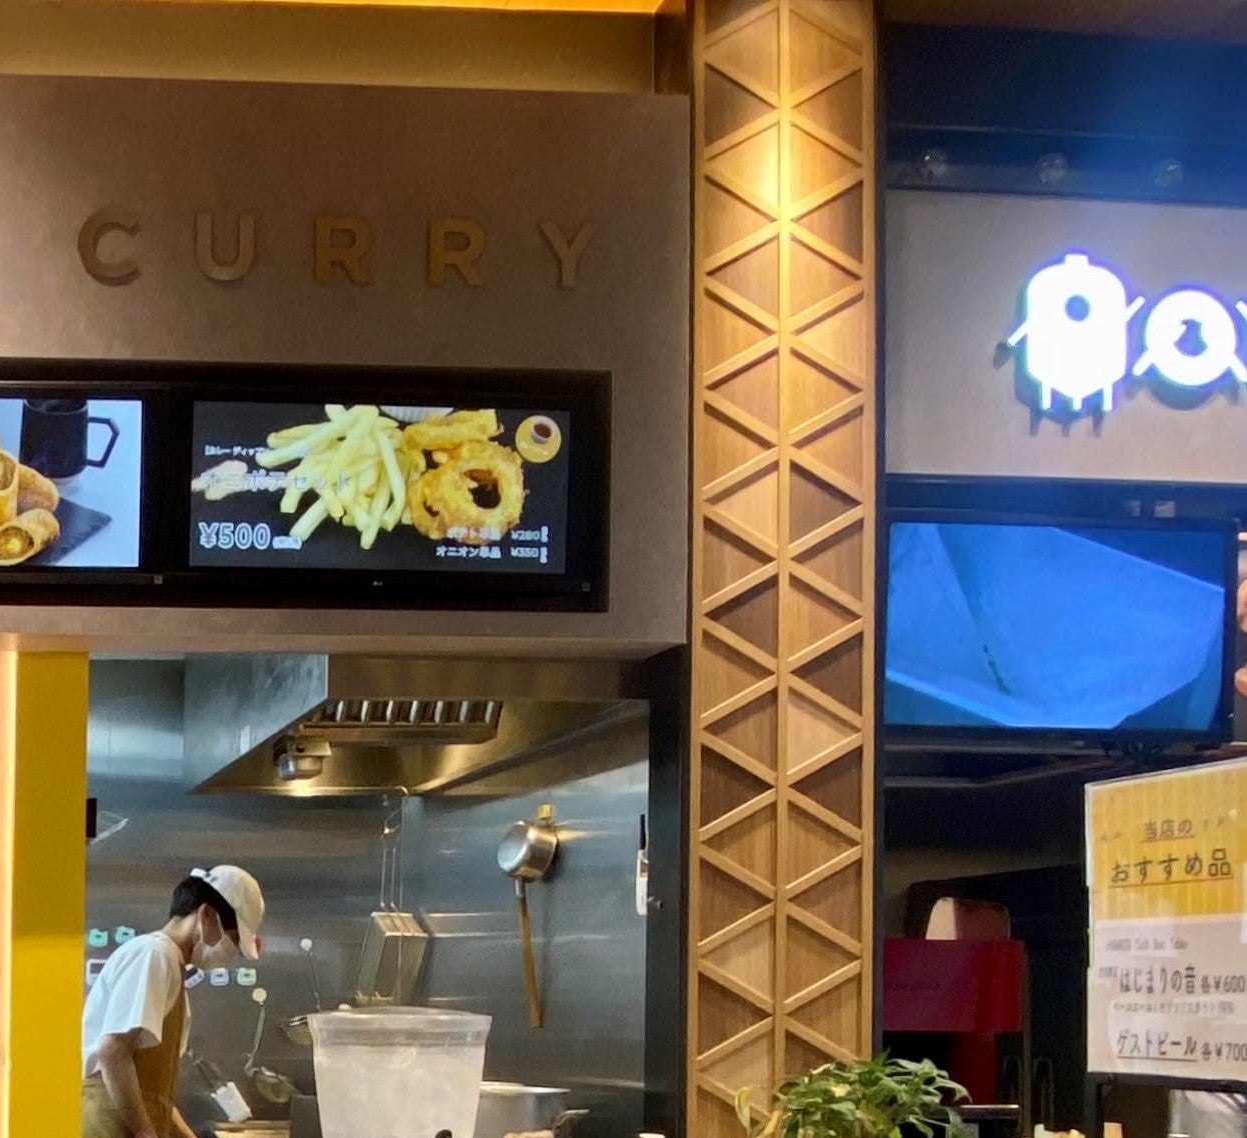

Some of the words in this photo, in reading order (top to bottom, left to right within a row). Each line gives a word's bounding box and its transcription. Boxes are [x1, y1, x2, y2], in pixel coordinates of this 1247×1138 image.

[78, 208, 592, 290] CURRY
[198, 521, 272, 550] ¥500
[1143, 817, 1193, 840] 当店の
[1110, 848, 1231, 884] おすすめ品
[1120, 963, 1196, 995] はじまりの音
[1117, 1028, 1198, 1057] ゲストビール
